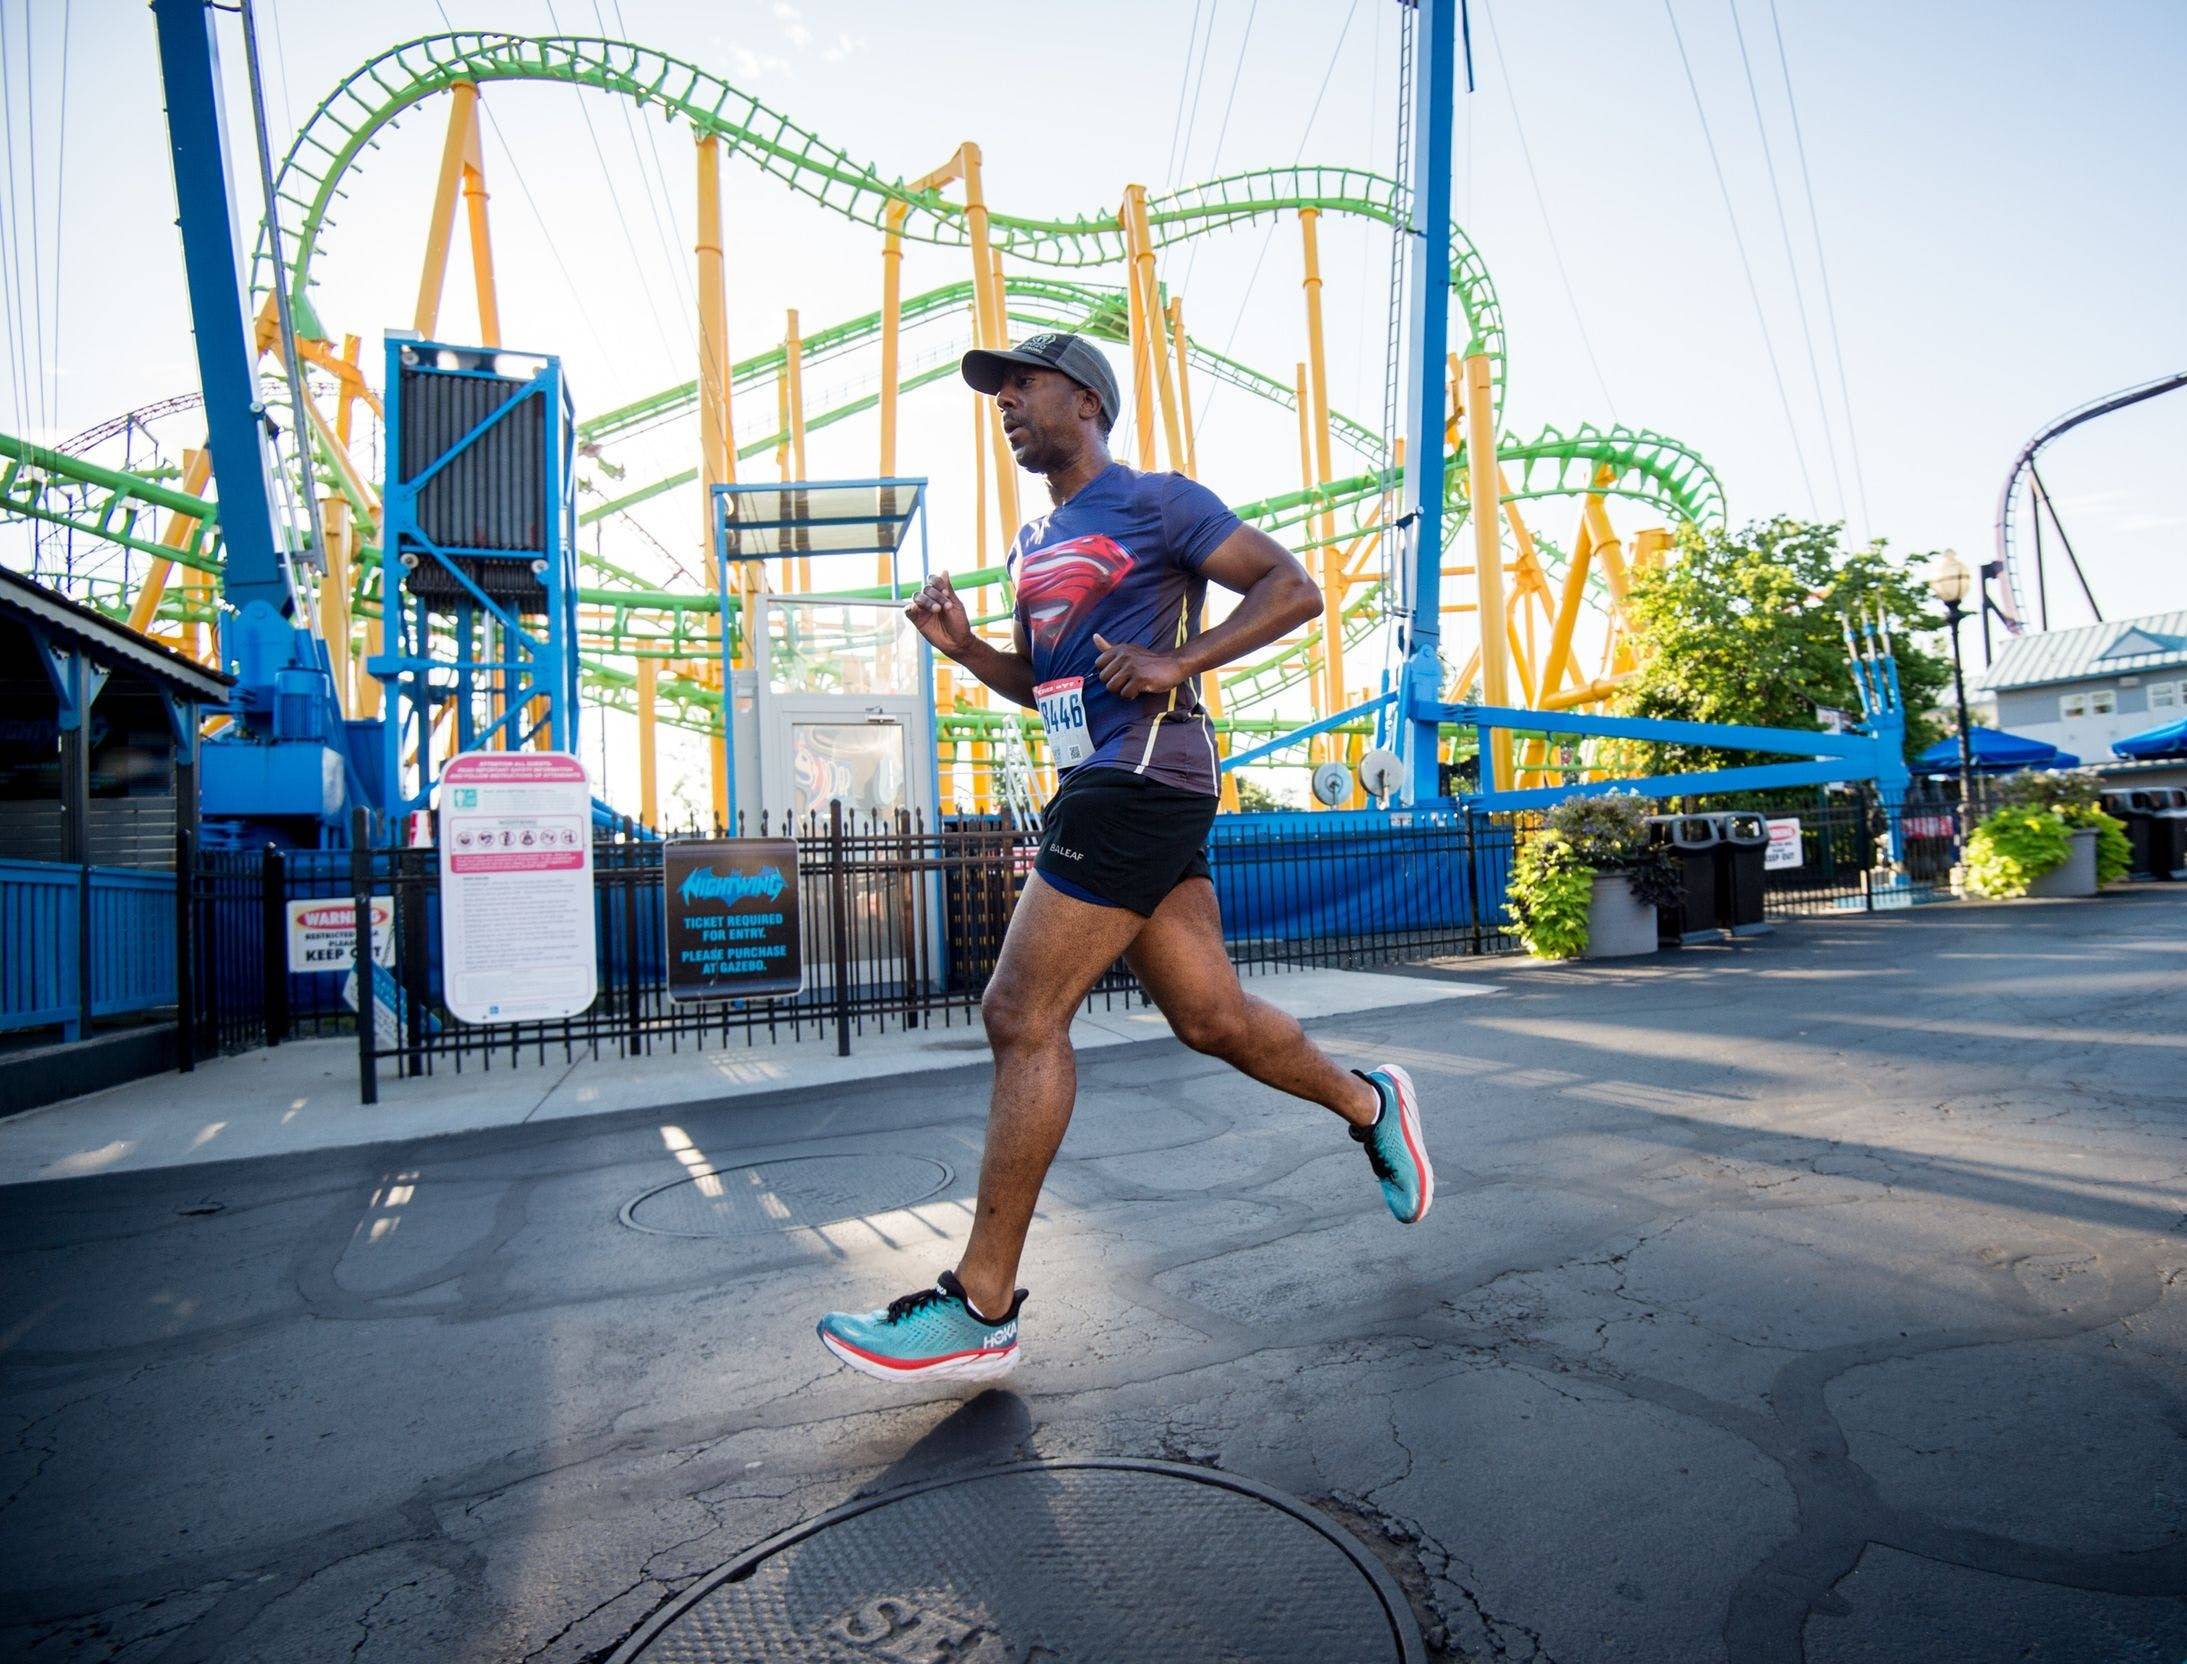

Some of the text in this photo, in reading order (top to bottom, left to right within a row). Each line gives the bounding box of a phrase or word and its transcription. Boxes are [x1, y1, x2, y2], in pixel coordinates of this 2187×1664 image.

[1050, 843, 1084, 861] BALEAF
[682, 866, 785, 906] NIGHTWING
[304, 909, 382, 926] WARNIG
[684, 913, 784, 929] TICKET REQUIRED
[703, 927, 767, 942] FOR ENTRY.
[306, 946, 382, 961] KEEP OT
[681, 945, 787, 962] PLEASE PURCHASE
[702, 960, 767, 975] AT GAZEBO.
[983, 1321, 1017, 1350] HOKA
